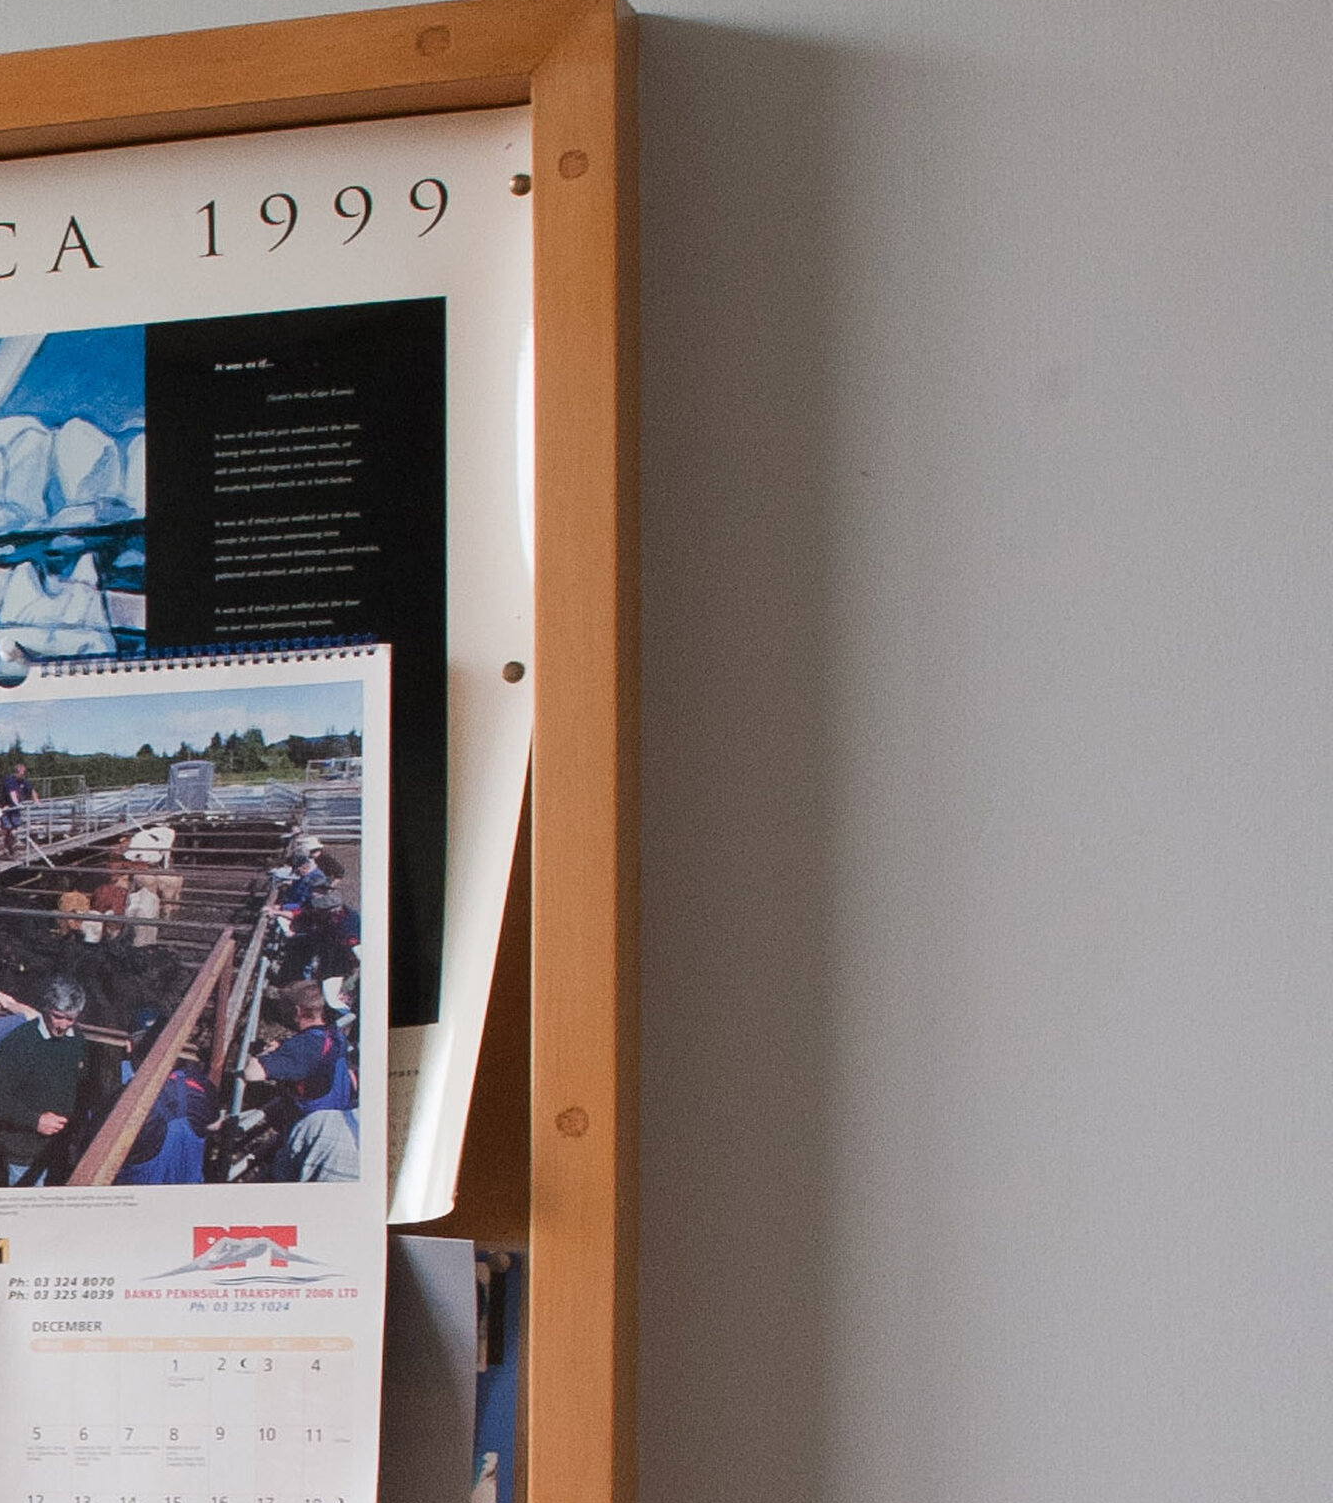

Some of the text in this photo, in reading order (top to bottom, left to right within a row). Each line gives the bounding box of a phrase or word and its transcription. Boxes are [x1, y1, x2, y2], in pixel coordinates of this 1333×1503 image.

[196, 177, 450, 259] 1999
[8, 1277, 30, 1288] Ph:
[33, 1277, 51, 1287] 03
[54, 1277, 77, 1287] 324
[81, 1276, 115, 1287] 8070
[8, 1290, 30, 1300] Ph:
[33, 1290, 50, 1300] 03
[54, 1290, 77, 1300] 325
[81, 1289, 115, 1300] 4039
[124, 1288, 162, 1299] BANKS
[165, 1288, 229, 1299] PENINSULA
[233, 1288, 301, 1299] TRANSPORT
[337, 1287, 359, 1298] LTD
[189, 1301, 290, 1312] Ph: 03 325 1024
[32, 1321, 102, 1333] DECEMBER
